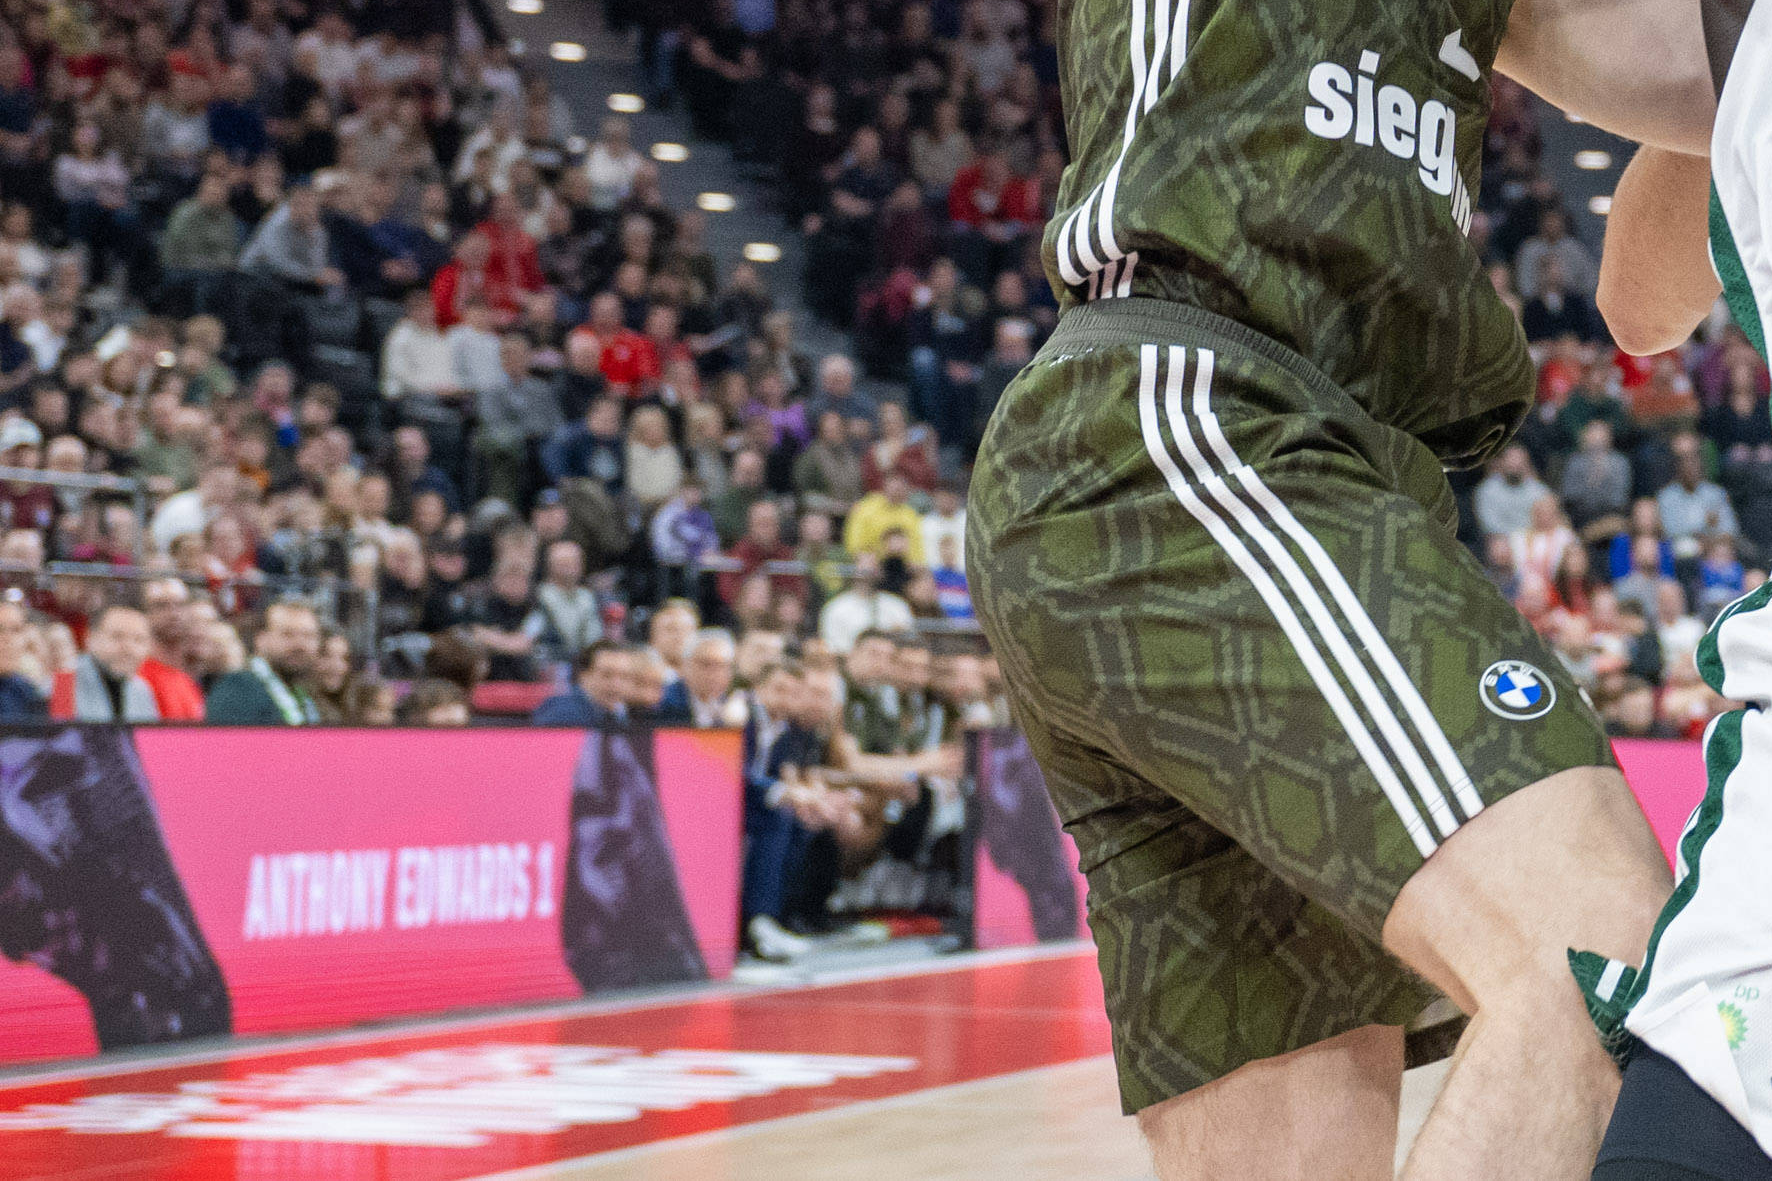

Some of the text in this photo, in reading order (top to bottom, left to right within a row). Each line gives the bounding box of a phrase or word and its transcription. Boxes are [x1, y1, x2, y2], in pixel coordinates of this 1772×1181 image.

[243, 842, 555, 940] ANTHONY EDWARDS 1
